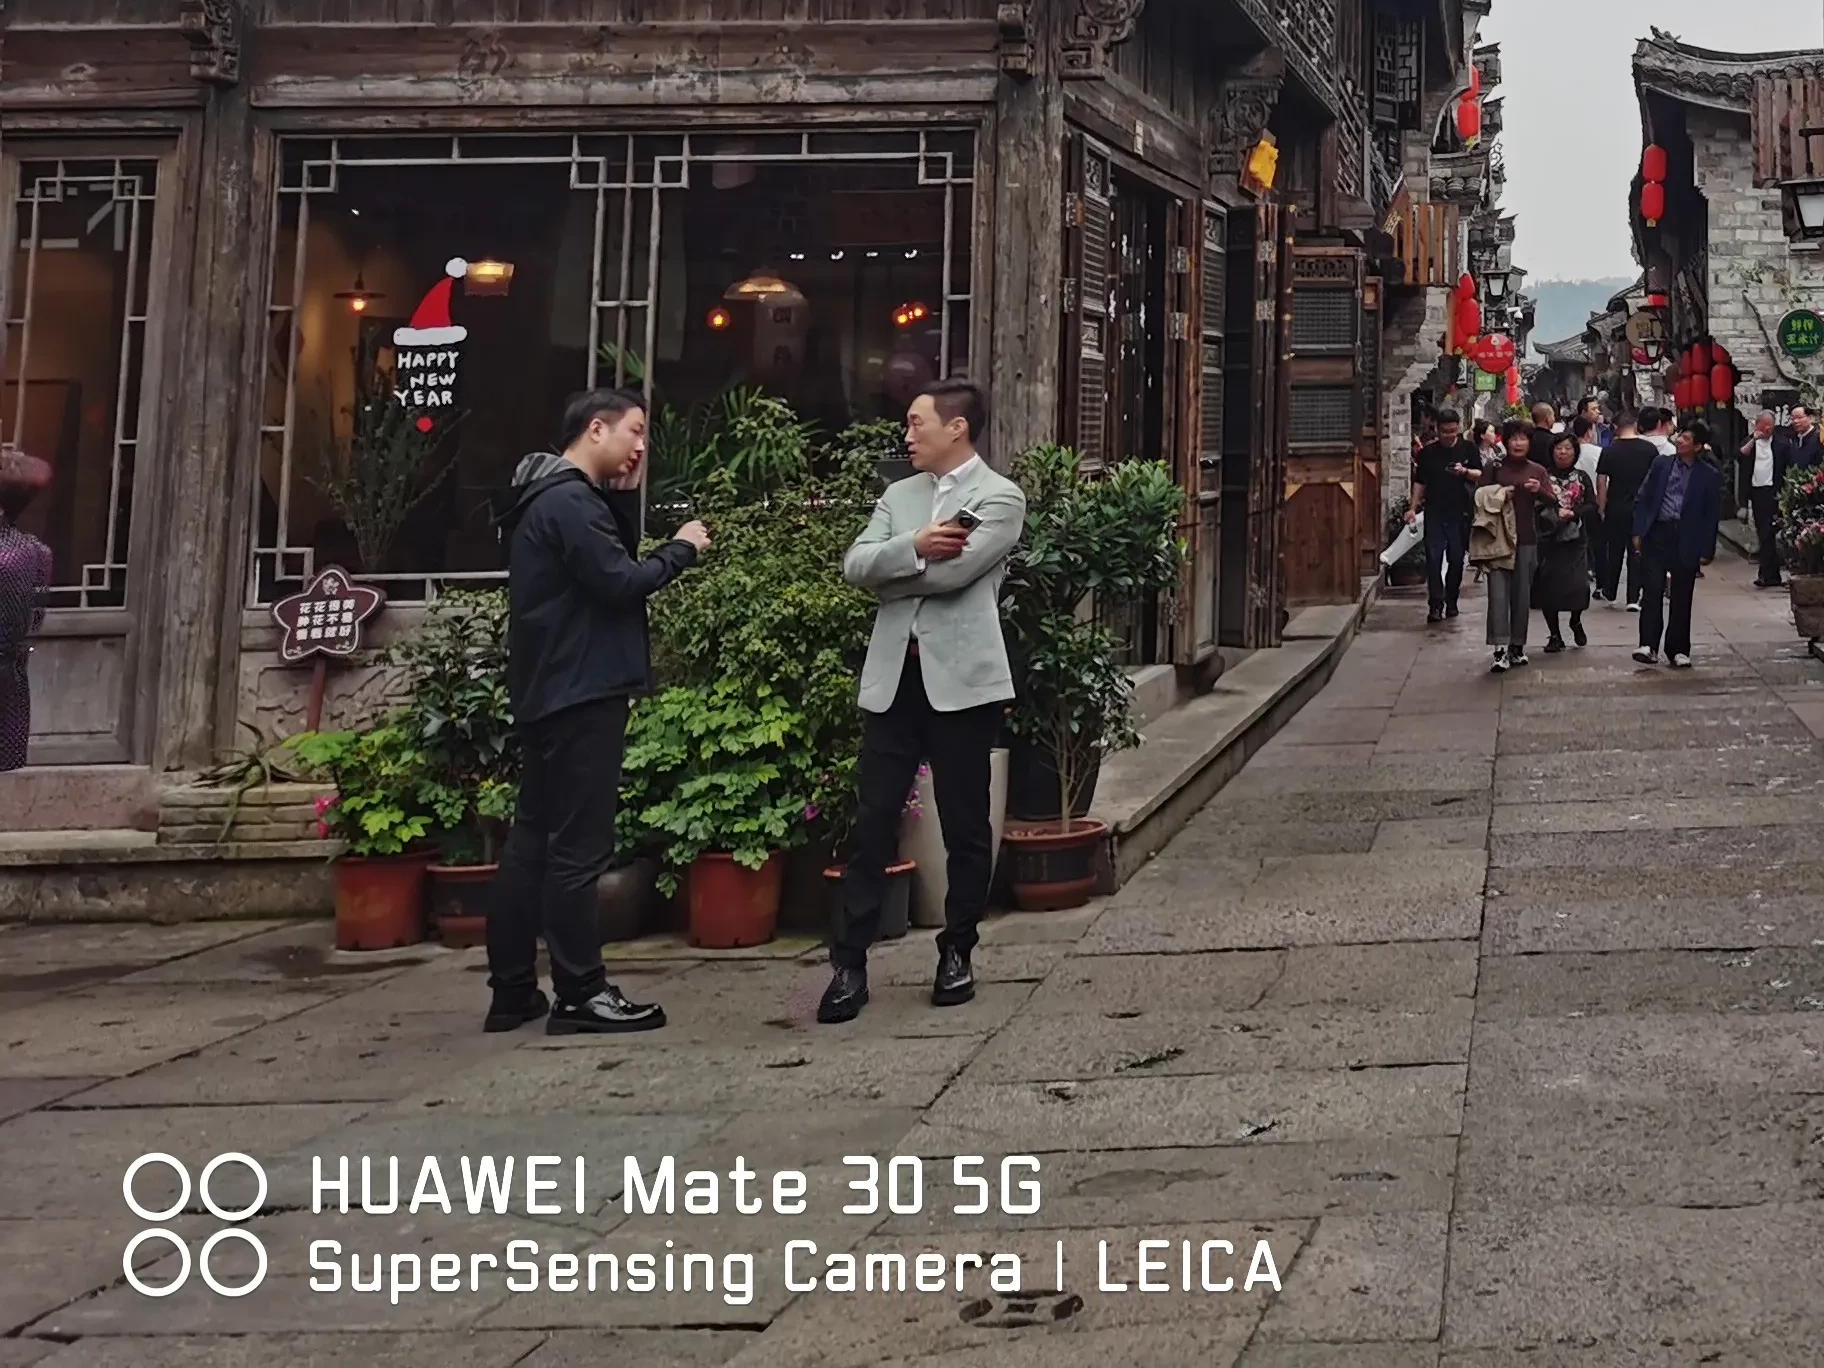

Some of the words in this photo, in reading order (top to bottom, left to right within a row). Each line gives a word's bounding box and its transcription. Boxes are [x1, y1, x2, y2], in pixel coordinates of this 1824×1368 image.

[397, 350, 460, 370] HAPPY
[410, 372, 457, 389] NEW
[393, 389, 454, 407] YEAR
